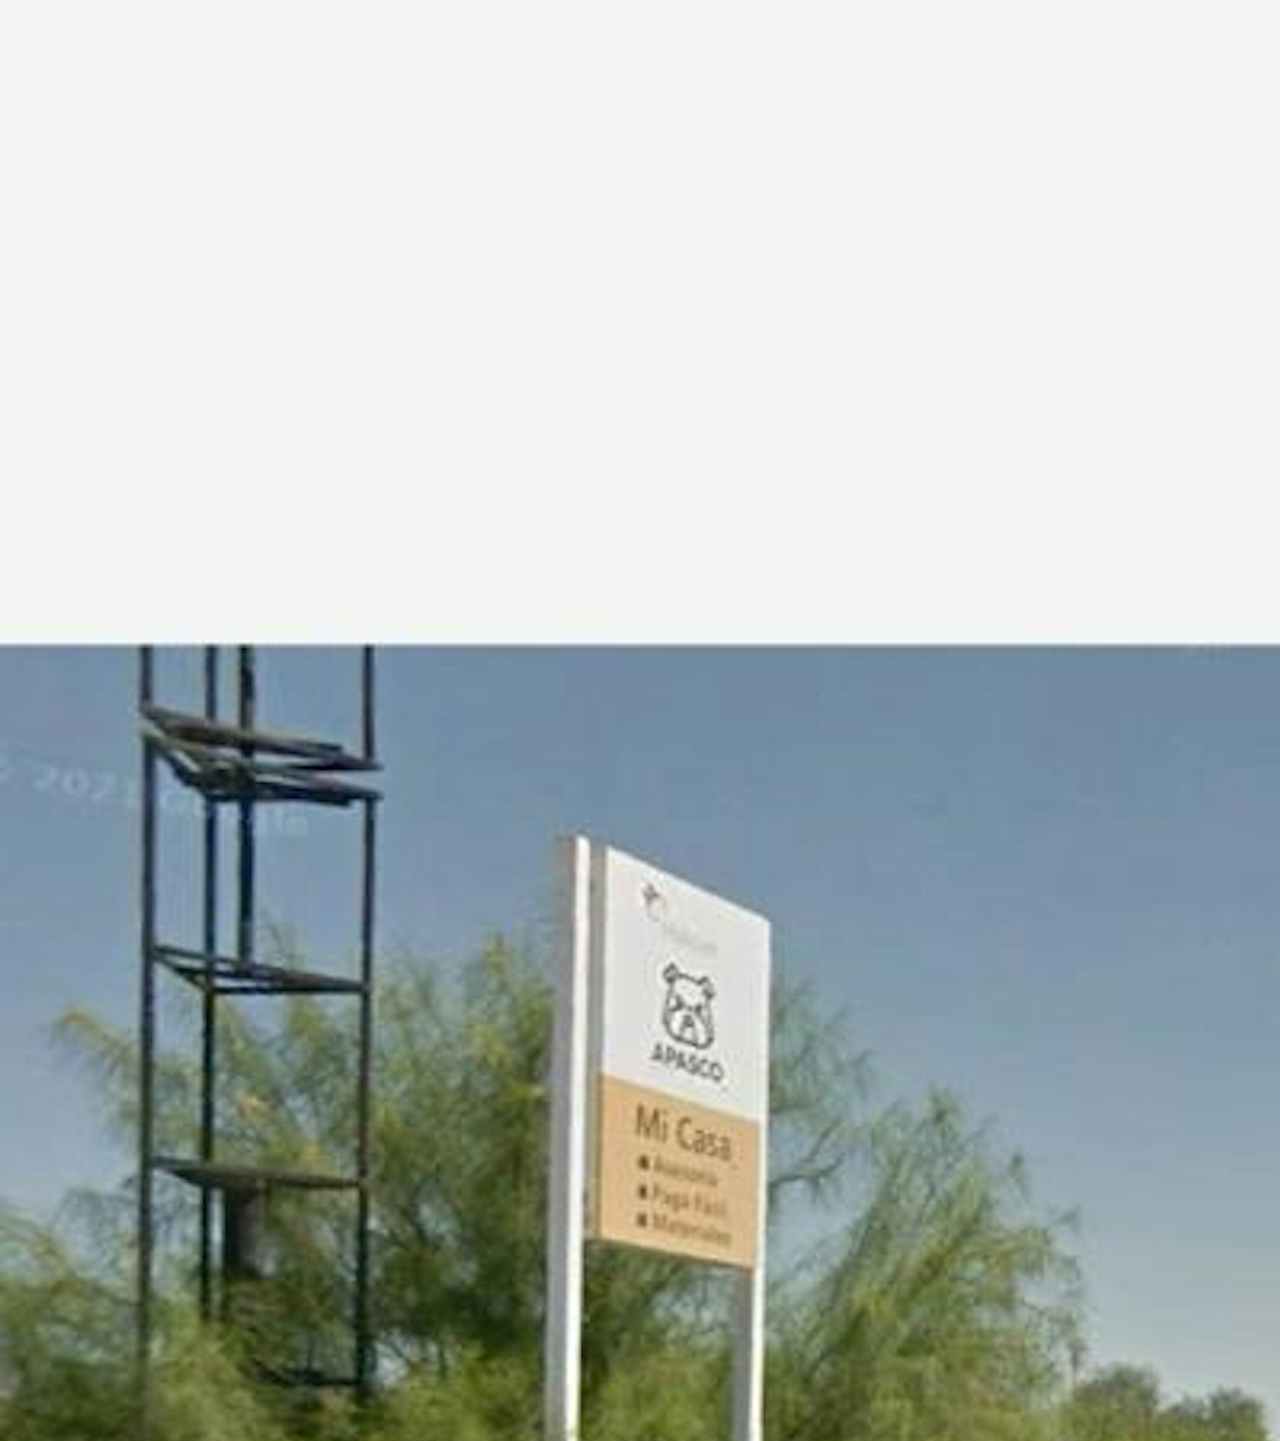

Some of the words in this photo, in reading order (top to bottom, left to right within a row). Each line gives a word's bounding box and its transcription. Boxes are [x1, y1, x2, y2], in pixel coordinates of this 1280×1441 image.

[650, 1042, 724, 1084] APASCO
[635, 1104, 669, 1143] Mi
[676, 1115, 733, 1162] Casa
